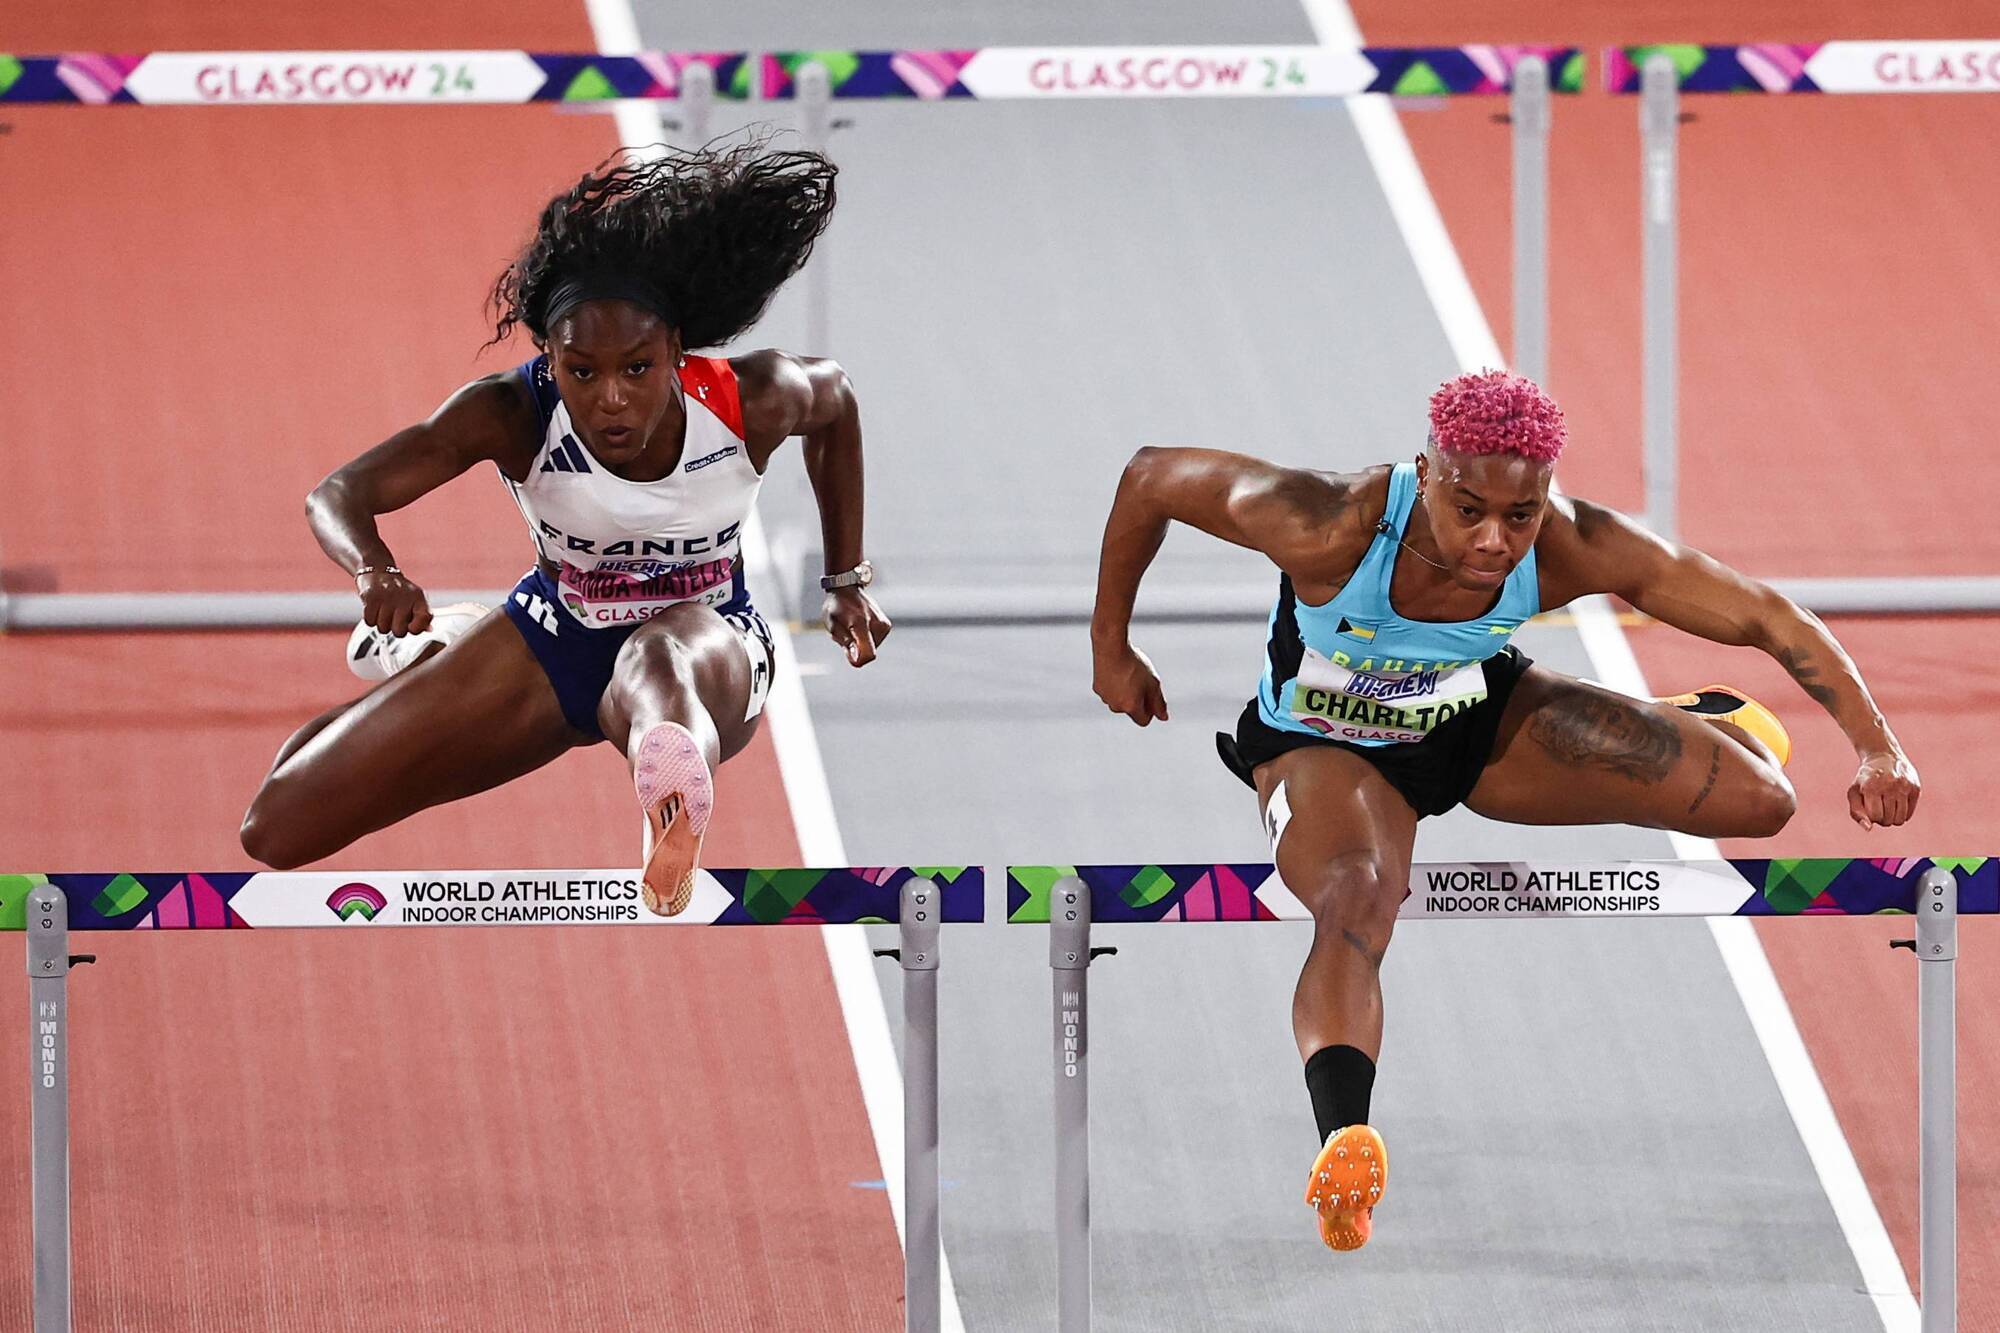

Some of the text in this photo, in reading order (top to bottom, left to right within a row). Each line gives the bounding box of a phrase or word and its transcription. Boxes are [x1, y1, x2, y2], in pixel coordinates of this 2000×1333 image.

[197, 65, 476, 98] GLASGOW 24
[1029, 58, 1307, 90] GLASGOW 24
[540, 519, 741, 556] FRANCE
[596, 589, 726, 622] GLASG 24
[1330, 650, 1482, 672] BAHAM
[1344, 671, 1440, 701] HI-CHEW
[1306, 689, 1477, 731] CHARLTON
[1342, 727, 1425, 741] GLASG
[403, 881, 638, 901] WORLD ATHLETICS
[1427, 871, 1660, 892] WORLD ATHLETICS
[402, 905, 638, 922] INDOOR CHAMPIONSHIPS
[1426, 896, 1660, 912] INDOOR CHAMPIONSHIPS
[40, 1022, 57, 1088] MONDO
[1063, 1011, 1079, 1077] MONDO
